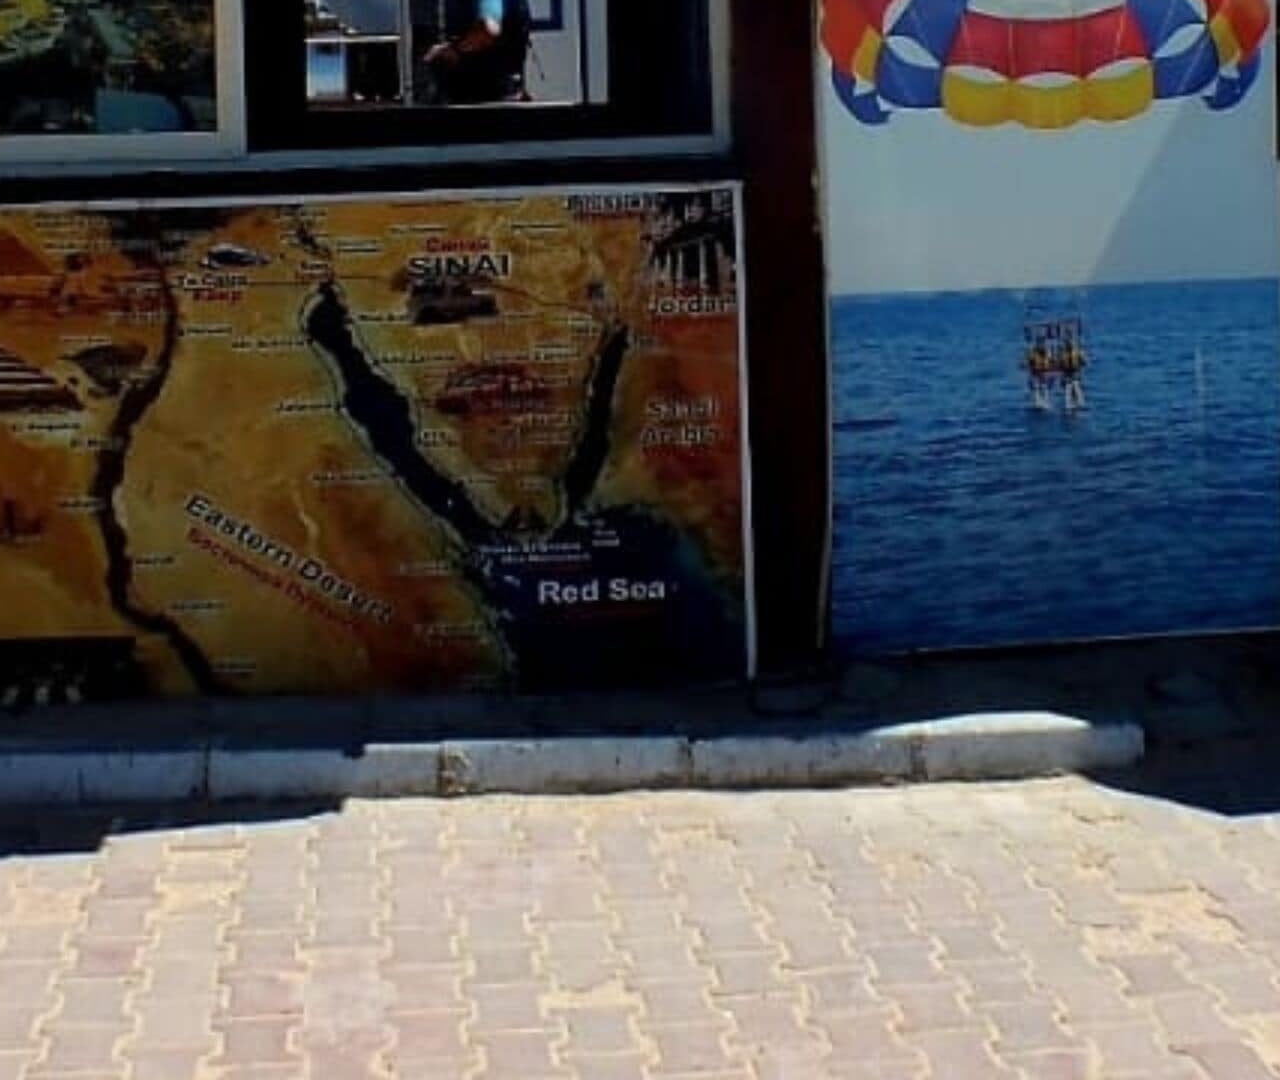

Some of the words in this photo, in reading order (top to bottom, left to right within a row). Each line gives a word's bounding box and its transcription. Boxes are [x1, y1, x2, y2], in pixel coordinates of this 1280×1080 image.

[407, 254, 510, 277] SINAI
[186, 494, 293, 568] Eastern
[298, 559, 393, 624] Desert
[537, 578, 600, 605] Red
[607, 576, 666, 602] Sea
